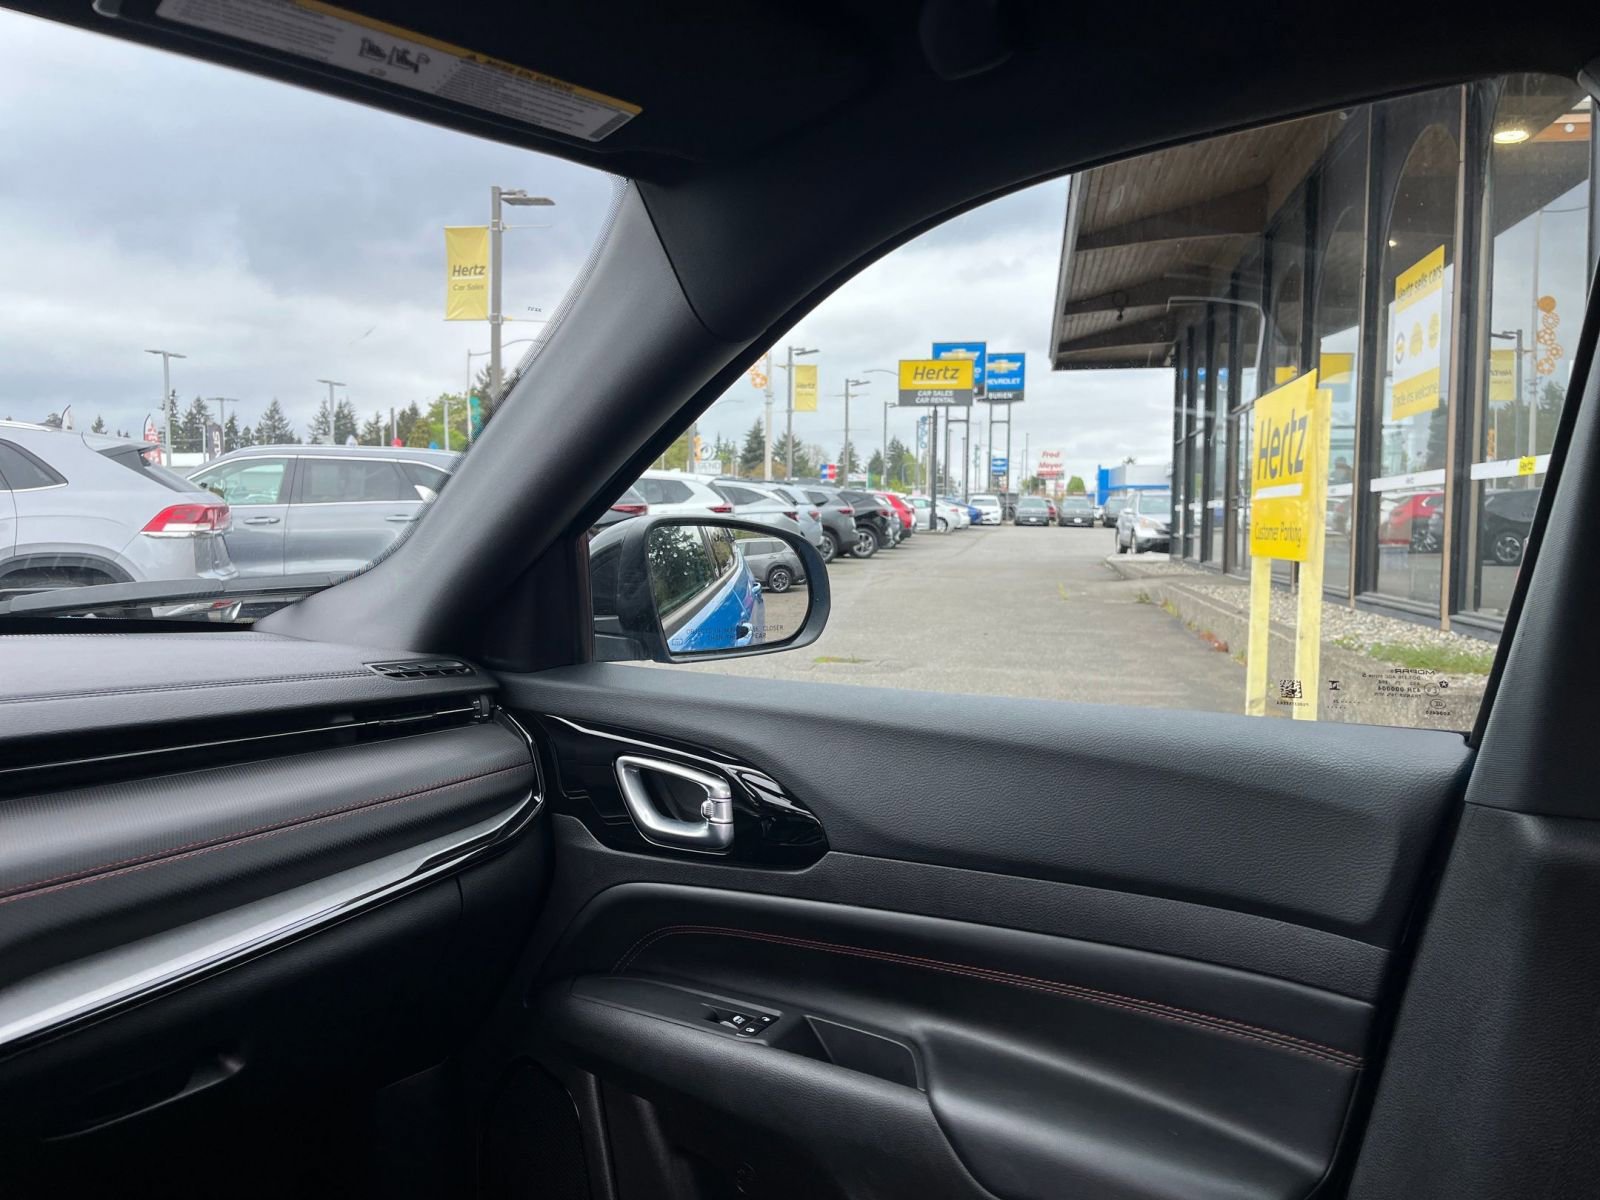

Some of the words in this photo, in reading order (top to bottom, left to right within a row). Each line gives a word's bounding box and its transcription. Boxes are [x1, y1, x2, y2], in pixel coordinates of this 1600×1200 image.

[452, 264, 486, 277] Hertz
[1429, 264, 1442, 285] cars
[913, 366, 960, 380] Hertz
[986, 377, 1021, 385] HEVROLET
[1257, 407, 1308, 481] Hertz
[1042, 450, 1061, 458] Fred
[1255, 521, 1280, 542] Customer
[1280, 520, 1302, 547] Parking
